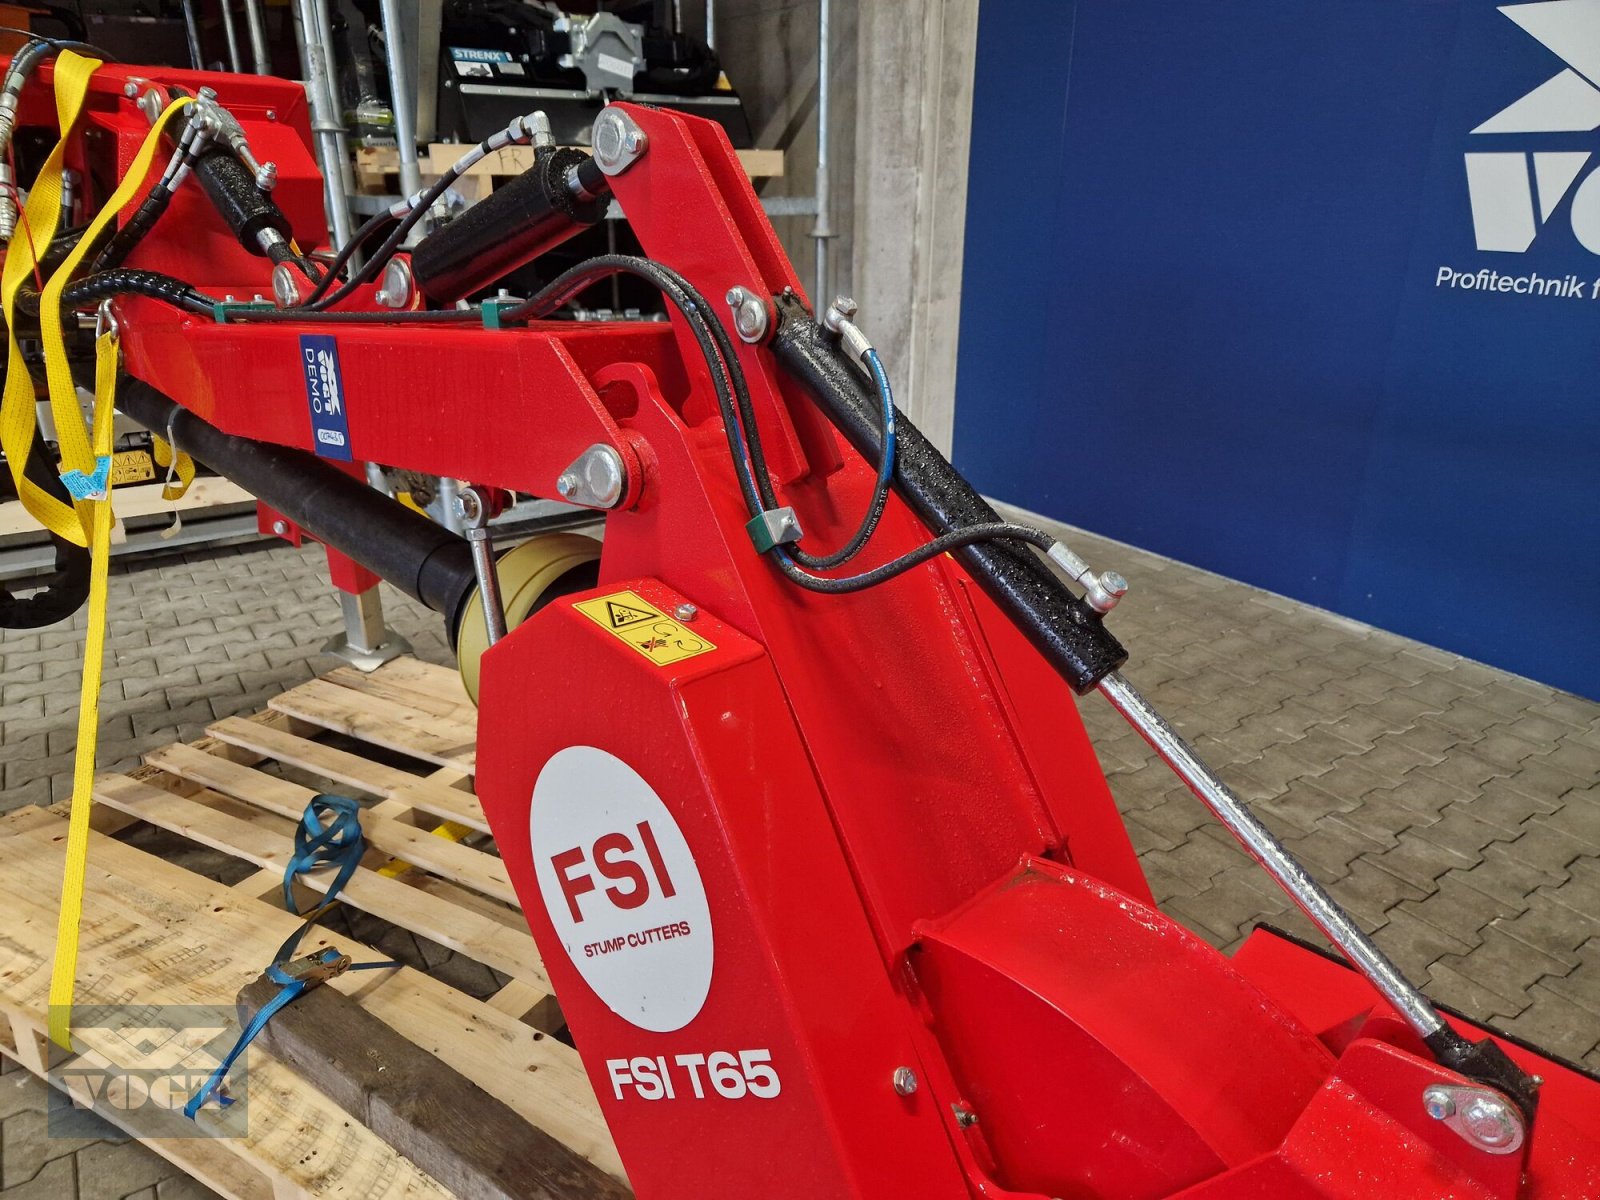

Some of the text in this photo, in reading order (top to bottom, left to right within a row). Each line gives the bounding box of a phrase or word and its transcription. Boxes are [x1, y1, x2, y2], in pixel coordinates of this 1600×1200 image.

[454, 48, 500, 60] STRENX
[1435, 266, 1586, 298] Profitechnik
[305, 348, 321, 413] DEMO
[550, 820, 676, 924] FSI
[584, 921, 691, 957] STUMP CUTTERS
[606, 1049, 781, 1100] FSI T65
